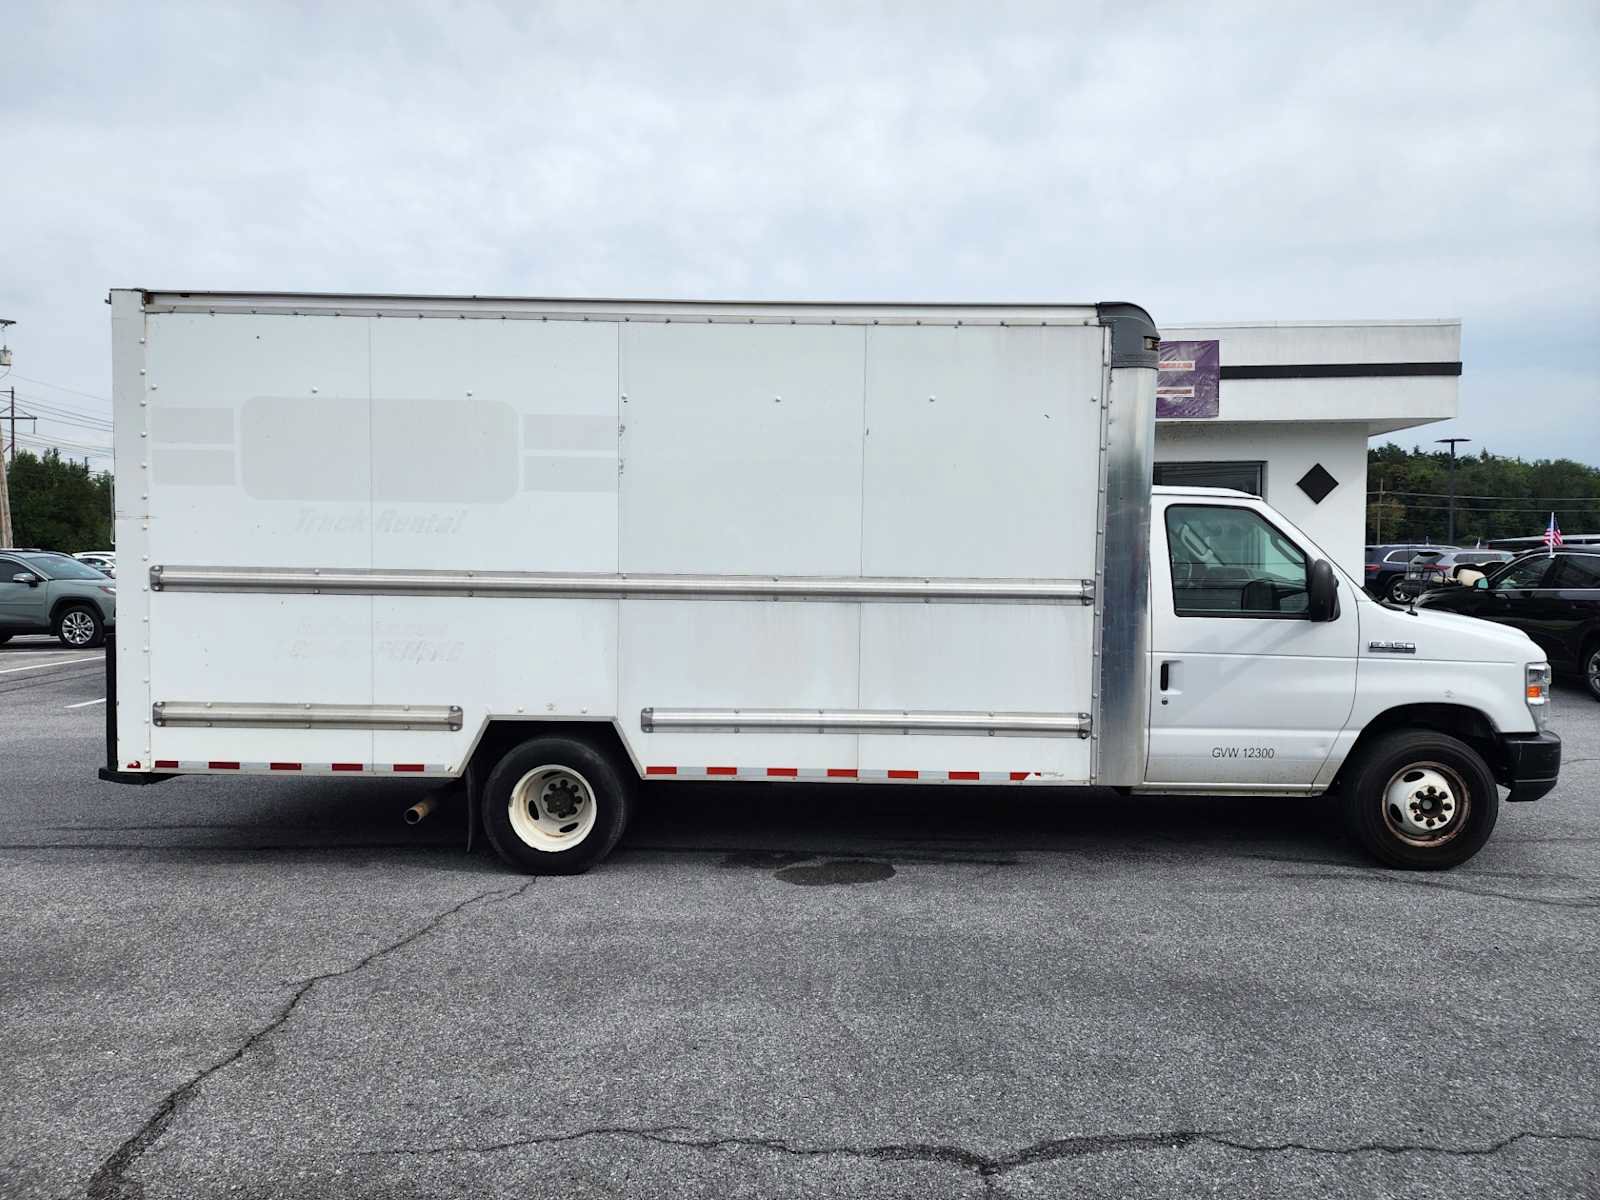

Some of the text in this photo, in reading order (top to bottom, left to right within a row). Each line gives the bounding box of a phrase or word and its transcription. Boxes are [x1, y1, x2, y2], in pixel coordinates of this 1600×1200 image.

[294, 506, 468, 535] Truck Rental
[1212, 747, 1275, 759] GVW 12300
